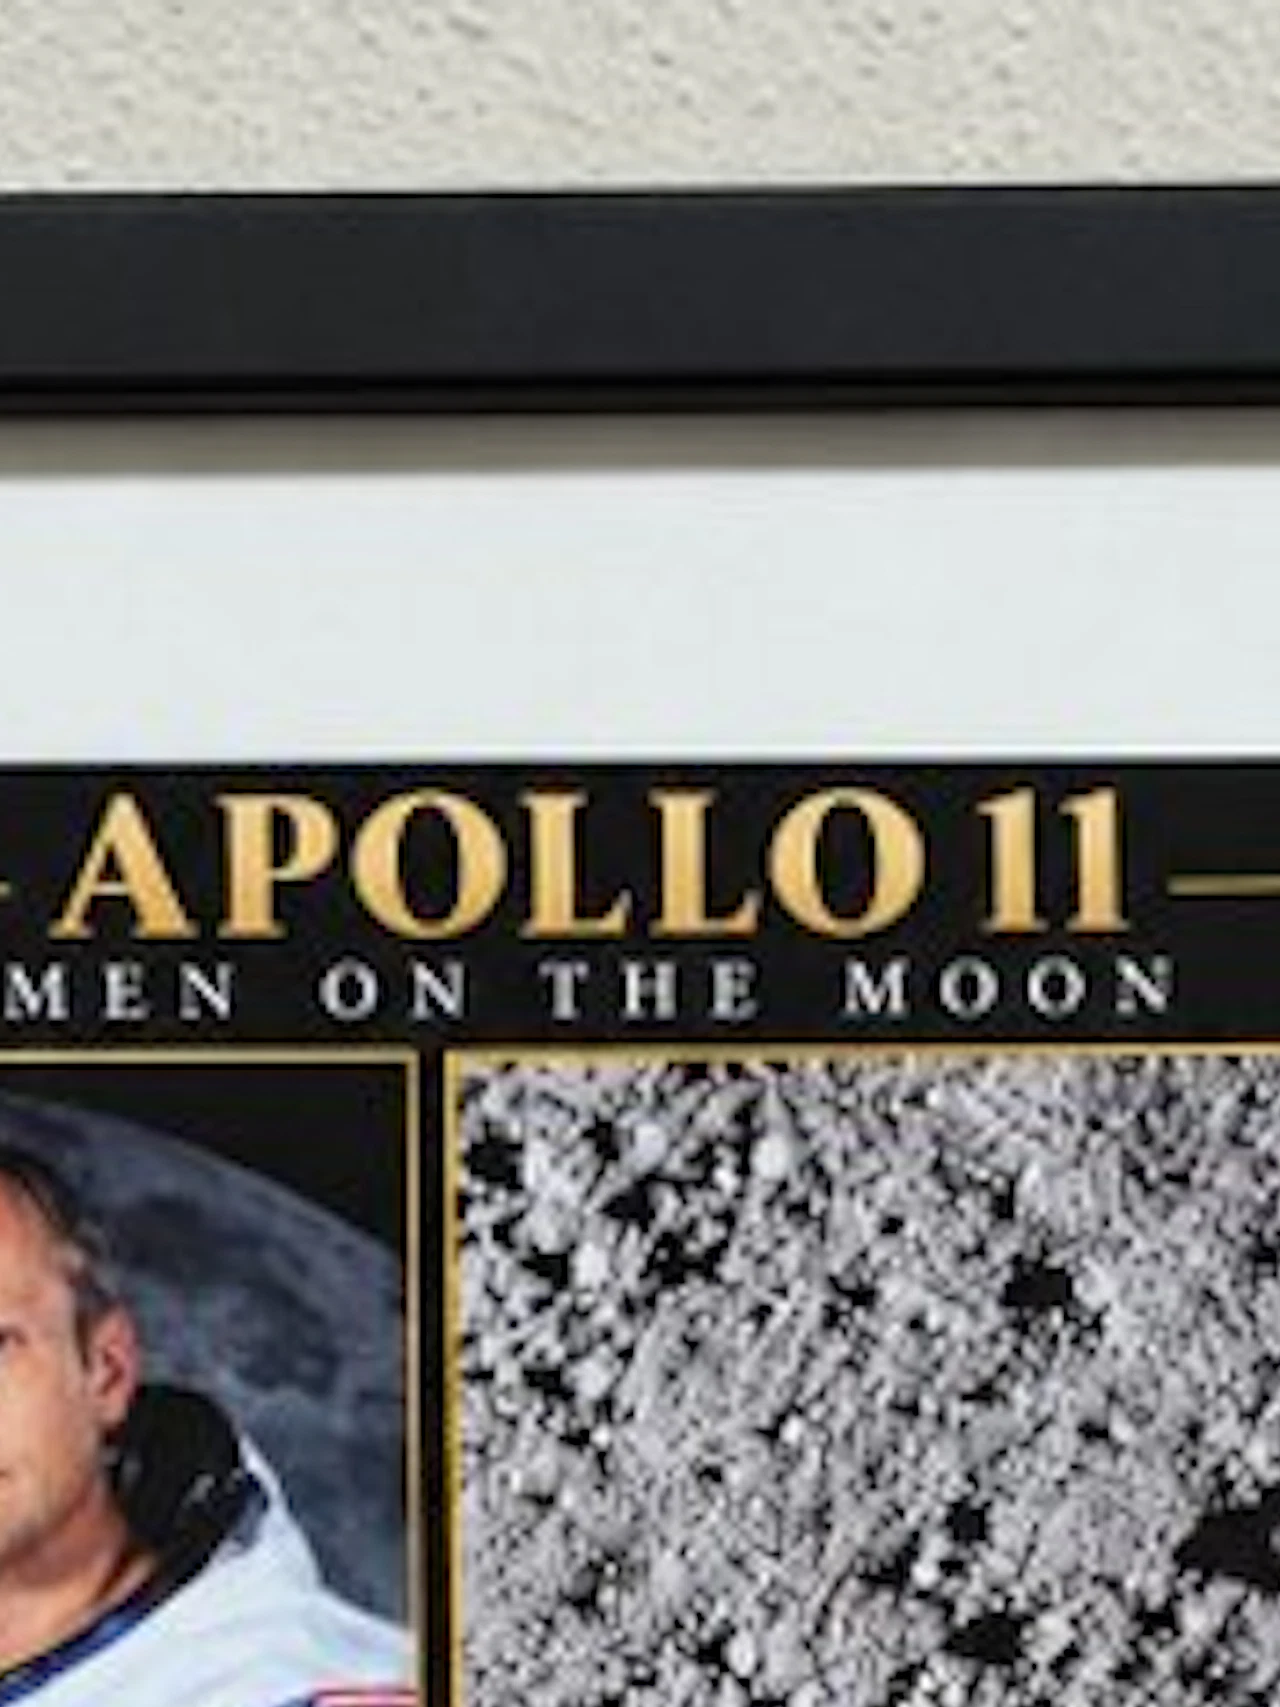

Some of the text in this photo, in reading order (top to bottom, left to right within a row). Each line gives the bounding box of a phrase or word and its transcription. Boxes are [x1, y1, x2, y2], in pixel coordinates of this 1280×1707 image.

[48, 785, 1129, 939] APOLLO 11
[4, 955, 1172, 1020] MEN ON THE MOON
